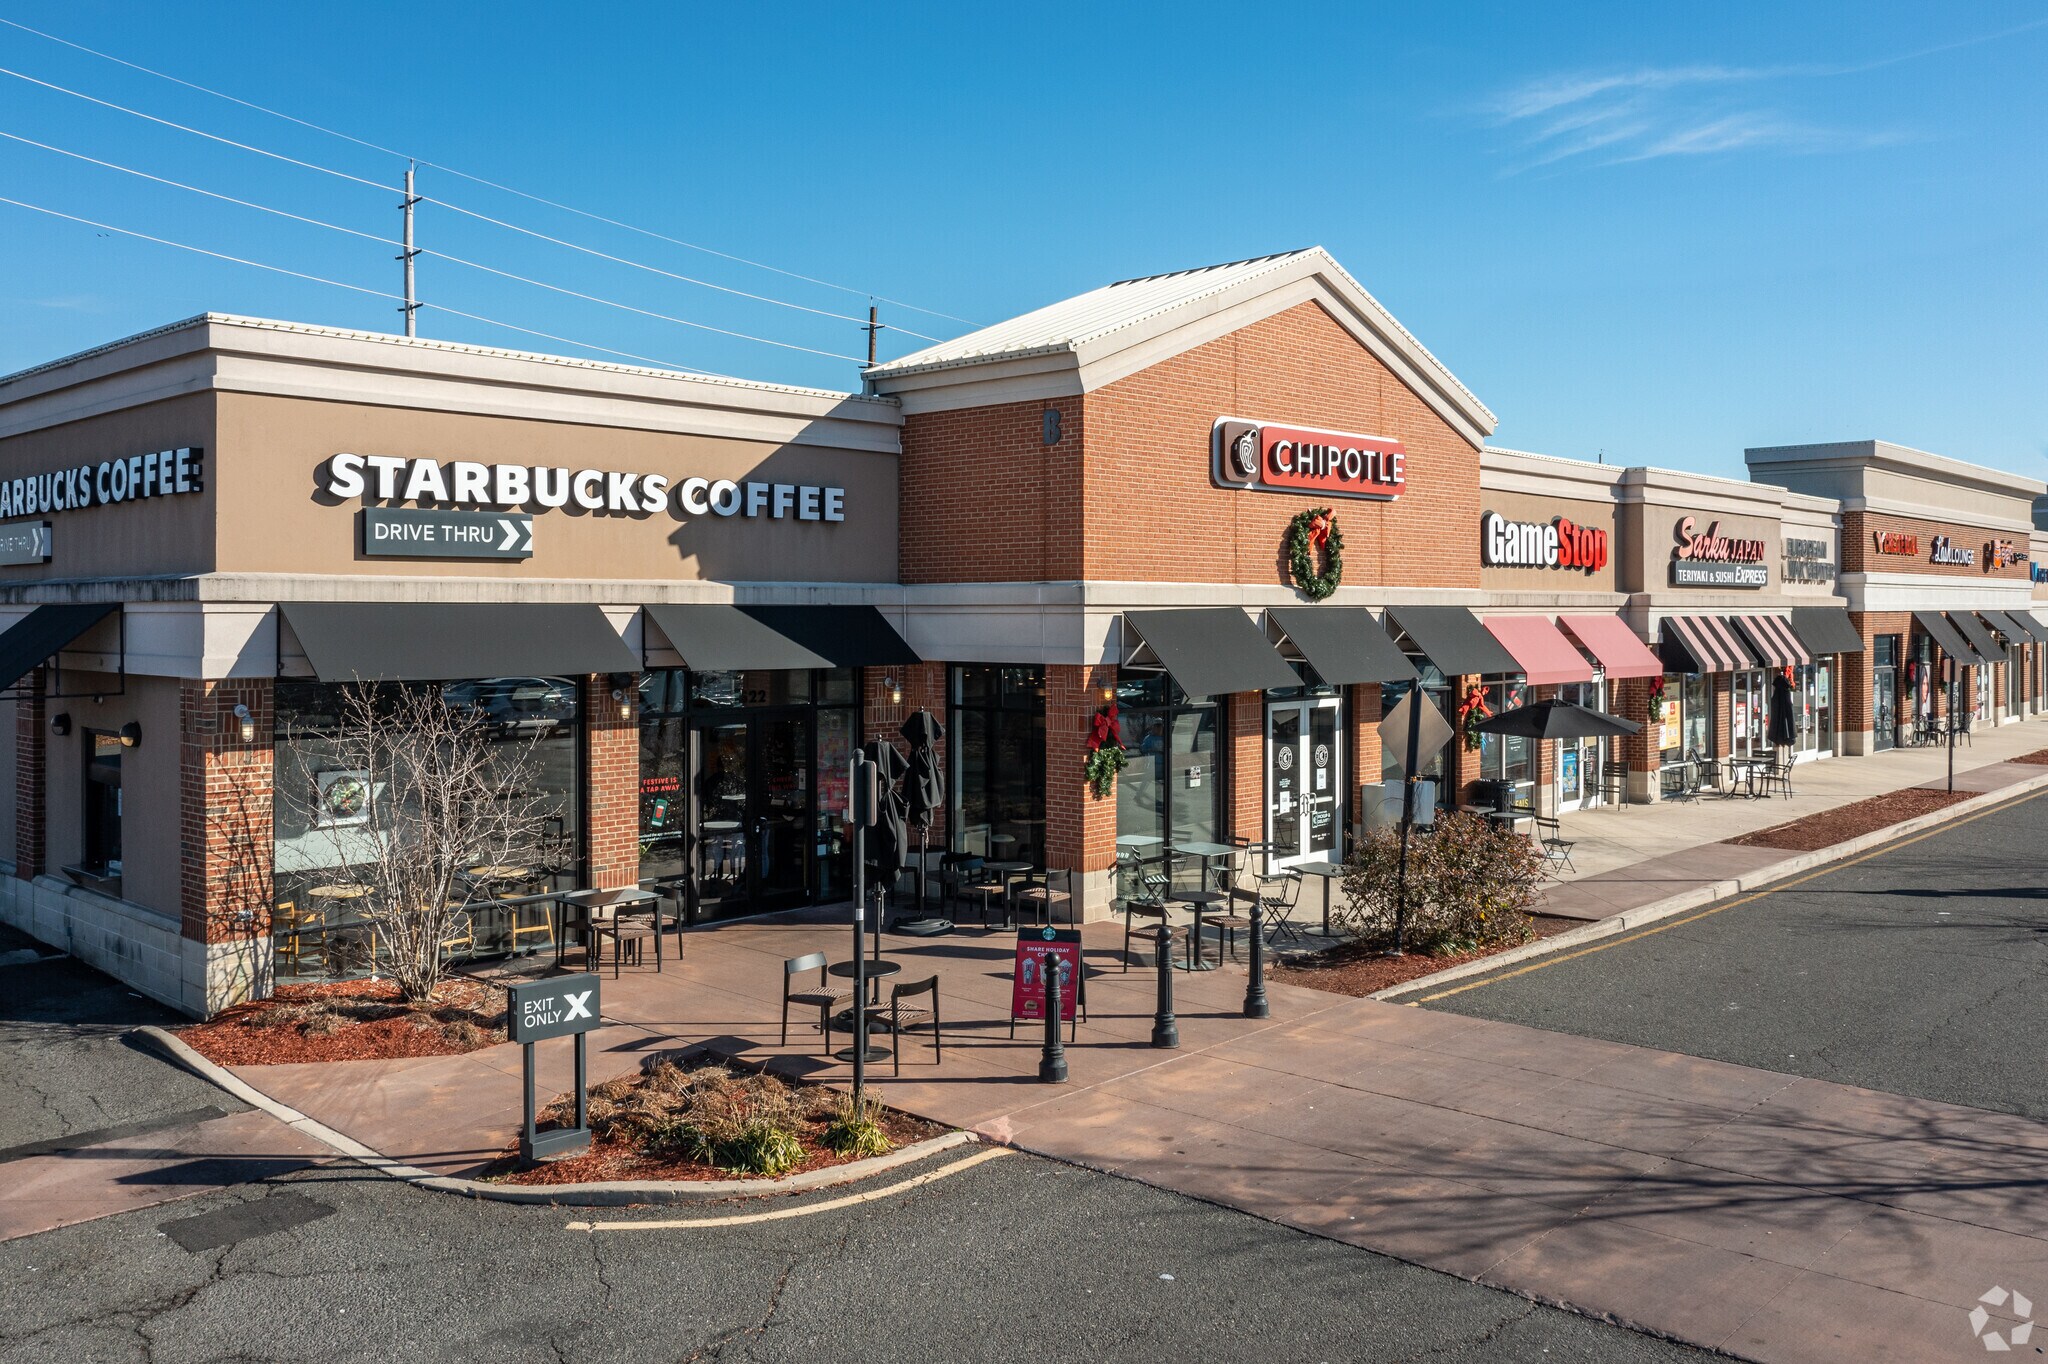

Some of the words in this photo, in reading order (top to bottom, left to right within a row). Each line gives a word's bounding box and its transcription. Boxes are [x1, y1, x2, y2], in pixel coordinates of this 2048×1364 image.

[1042, 409, 1061, 445] B
[97, 447, 191, 504] COFFEE
[1276, 440, 1405, 483] CHIPOTLE
[329, 453, 668, 513] STARBUCKS
[681, 477, 845, 521] COFFEE
[374, 522, 435, 542] DRIVE
[441, 525, 494, 543] THRU
[1488, 513, 1608, 572] GameStop
[1678, 516, 1730, 560] Sarku
[1731, 539, 1765, 561] JAPAN
[1678, 569, 1708, 582] TERIYAKI
[1709, 573, 1715, 582] &
[1715, 571, 1734, 583] SUSHI
[1735, 566, 1767, 584] EXPRESS
[640, 786, 645, 794] A
[646, 785, 659, 793] TAP
[660, 784, 680, 792] AWAY
[643, 777, 669, 786] FESTIVE
[524, 997, 555, 1014] EXIT
[524, 1010, 562, 1028] ONLY
